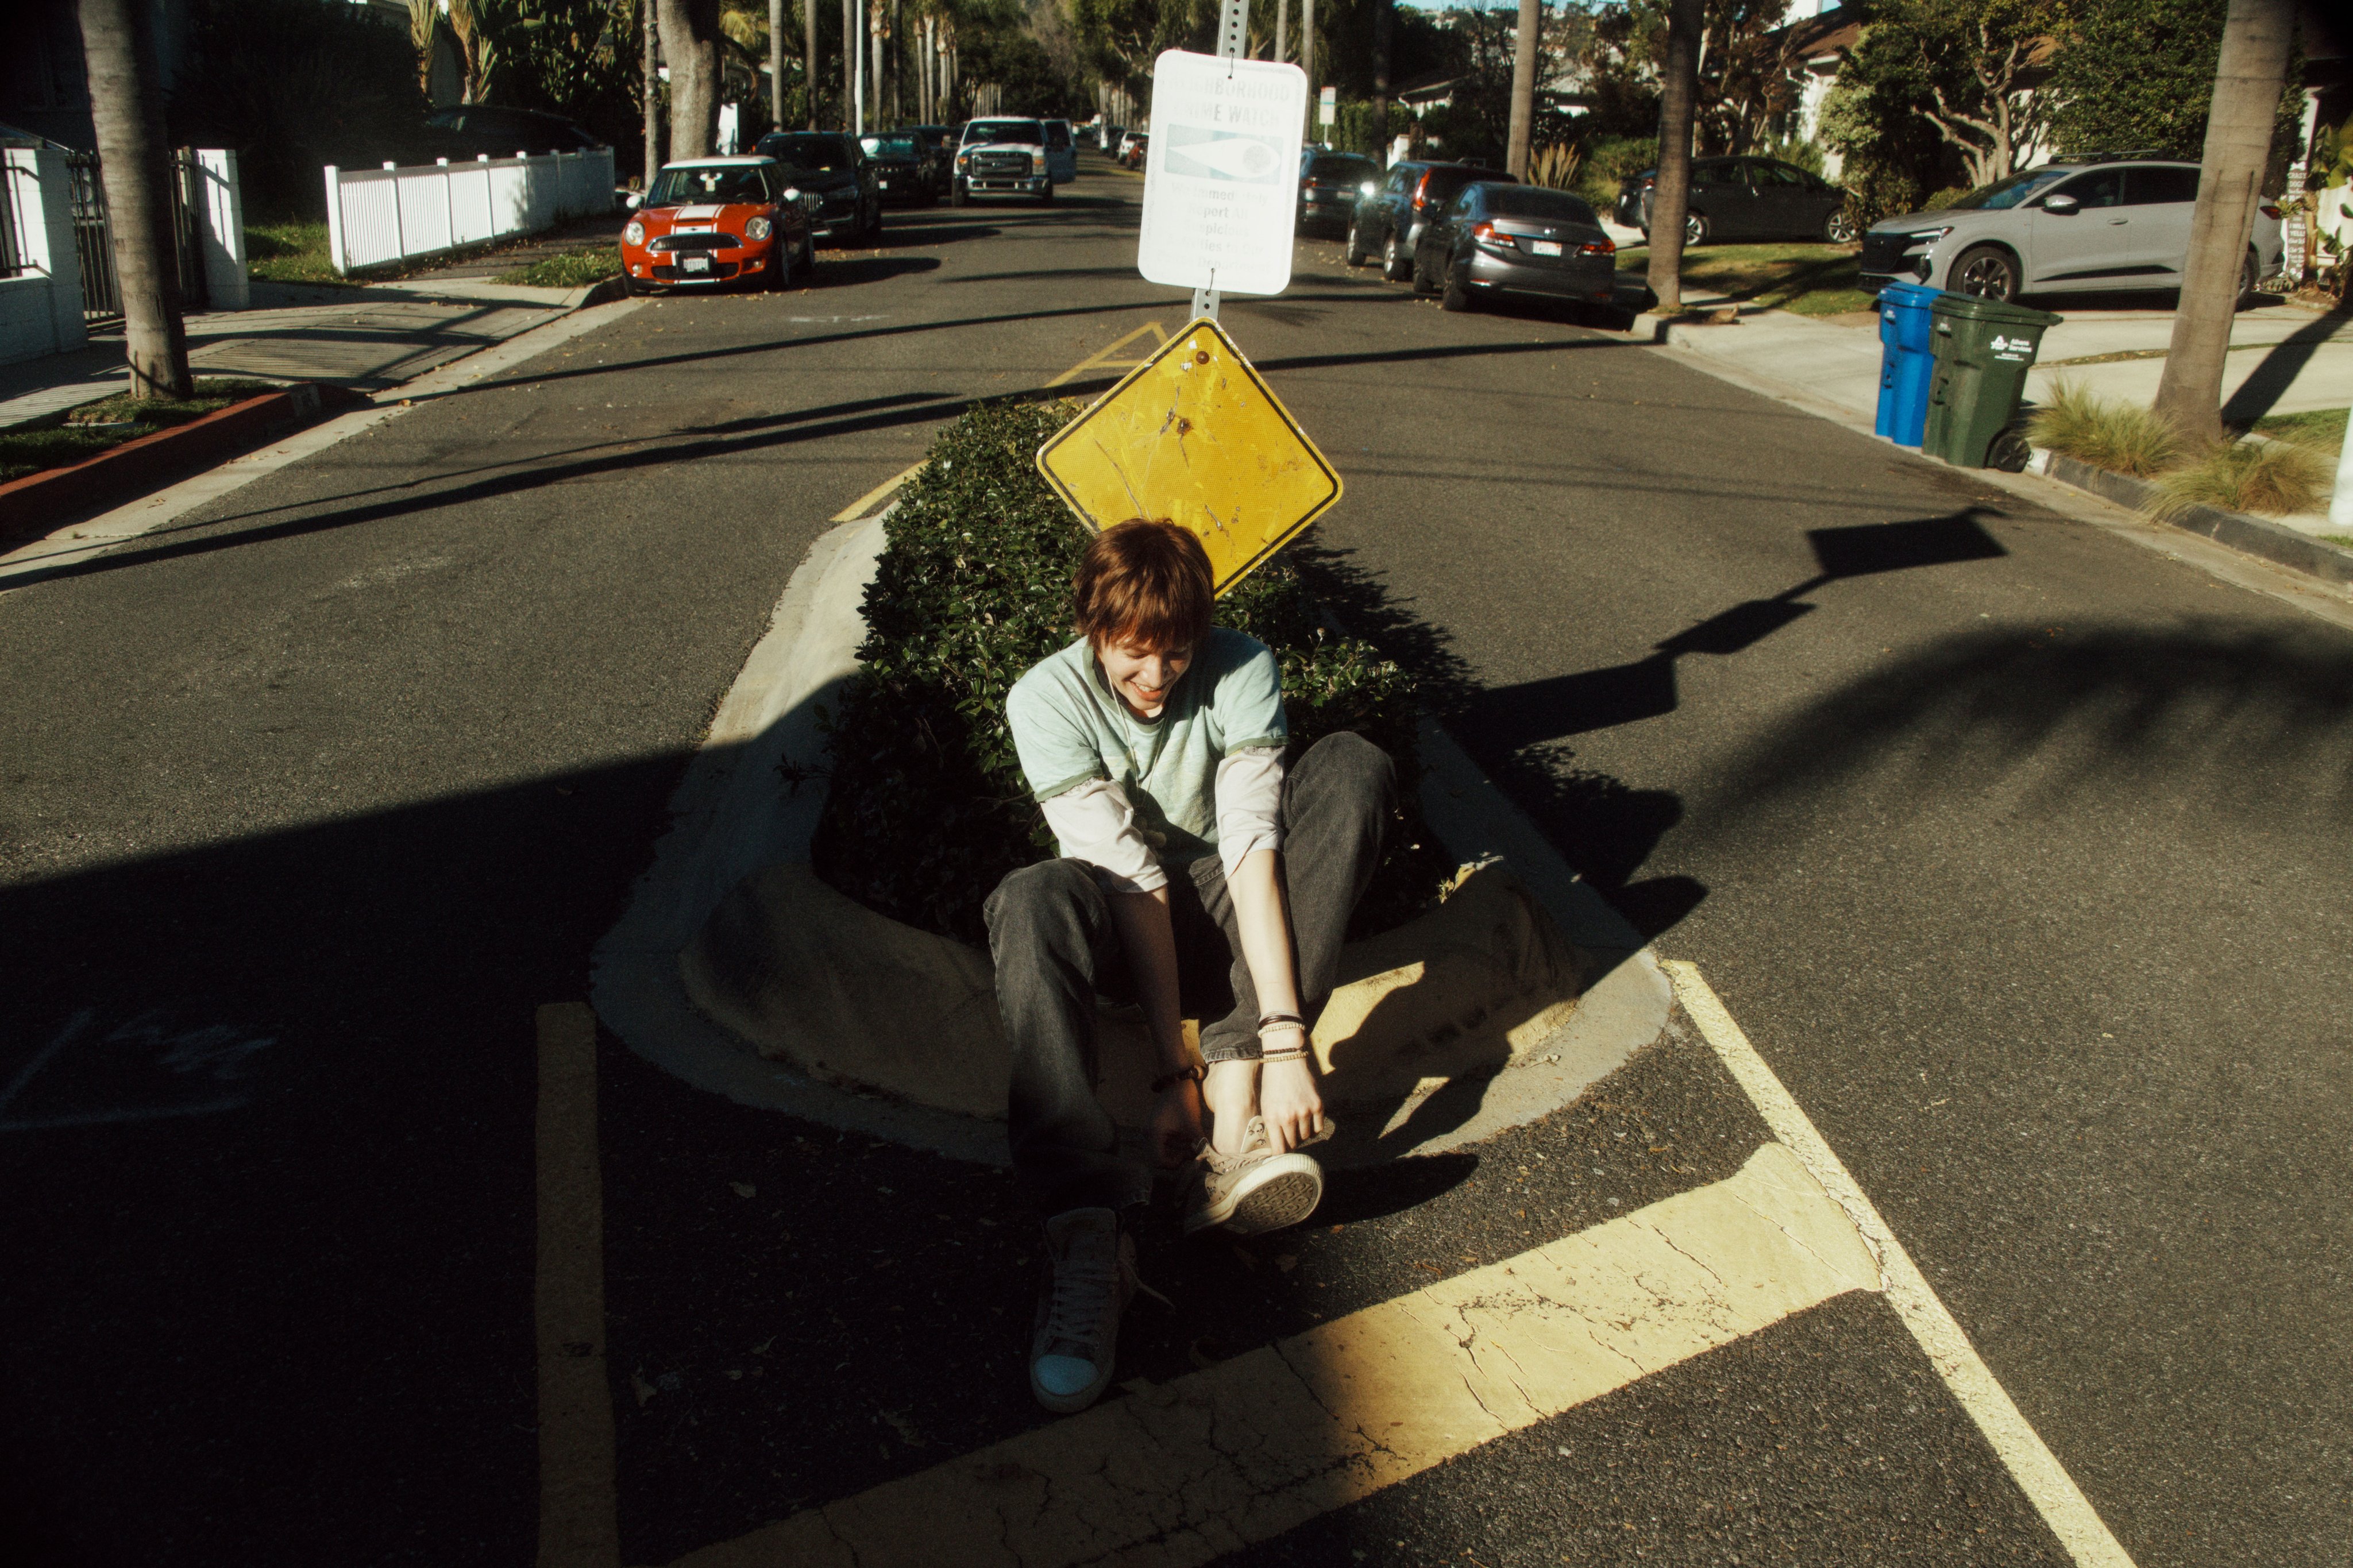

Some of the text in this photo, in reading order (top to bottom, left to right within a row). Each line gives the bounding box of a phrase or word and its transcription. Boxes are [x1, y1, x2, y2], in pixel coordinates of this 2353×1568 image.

[1169, 75, 1290, 102] IGHBORHOOD
[1228, 105, 1279, 128] WATCH
[1194, 185, 1268, 206] Immedtely
[1167, 232, 1222, 252] Ativities
[1198, 256, 1271, 273] Departmt
